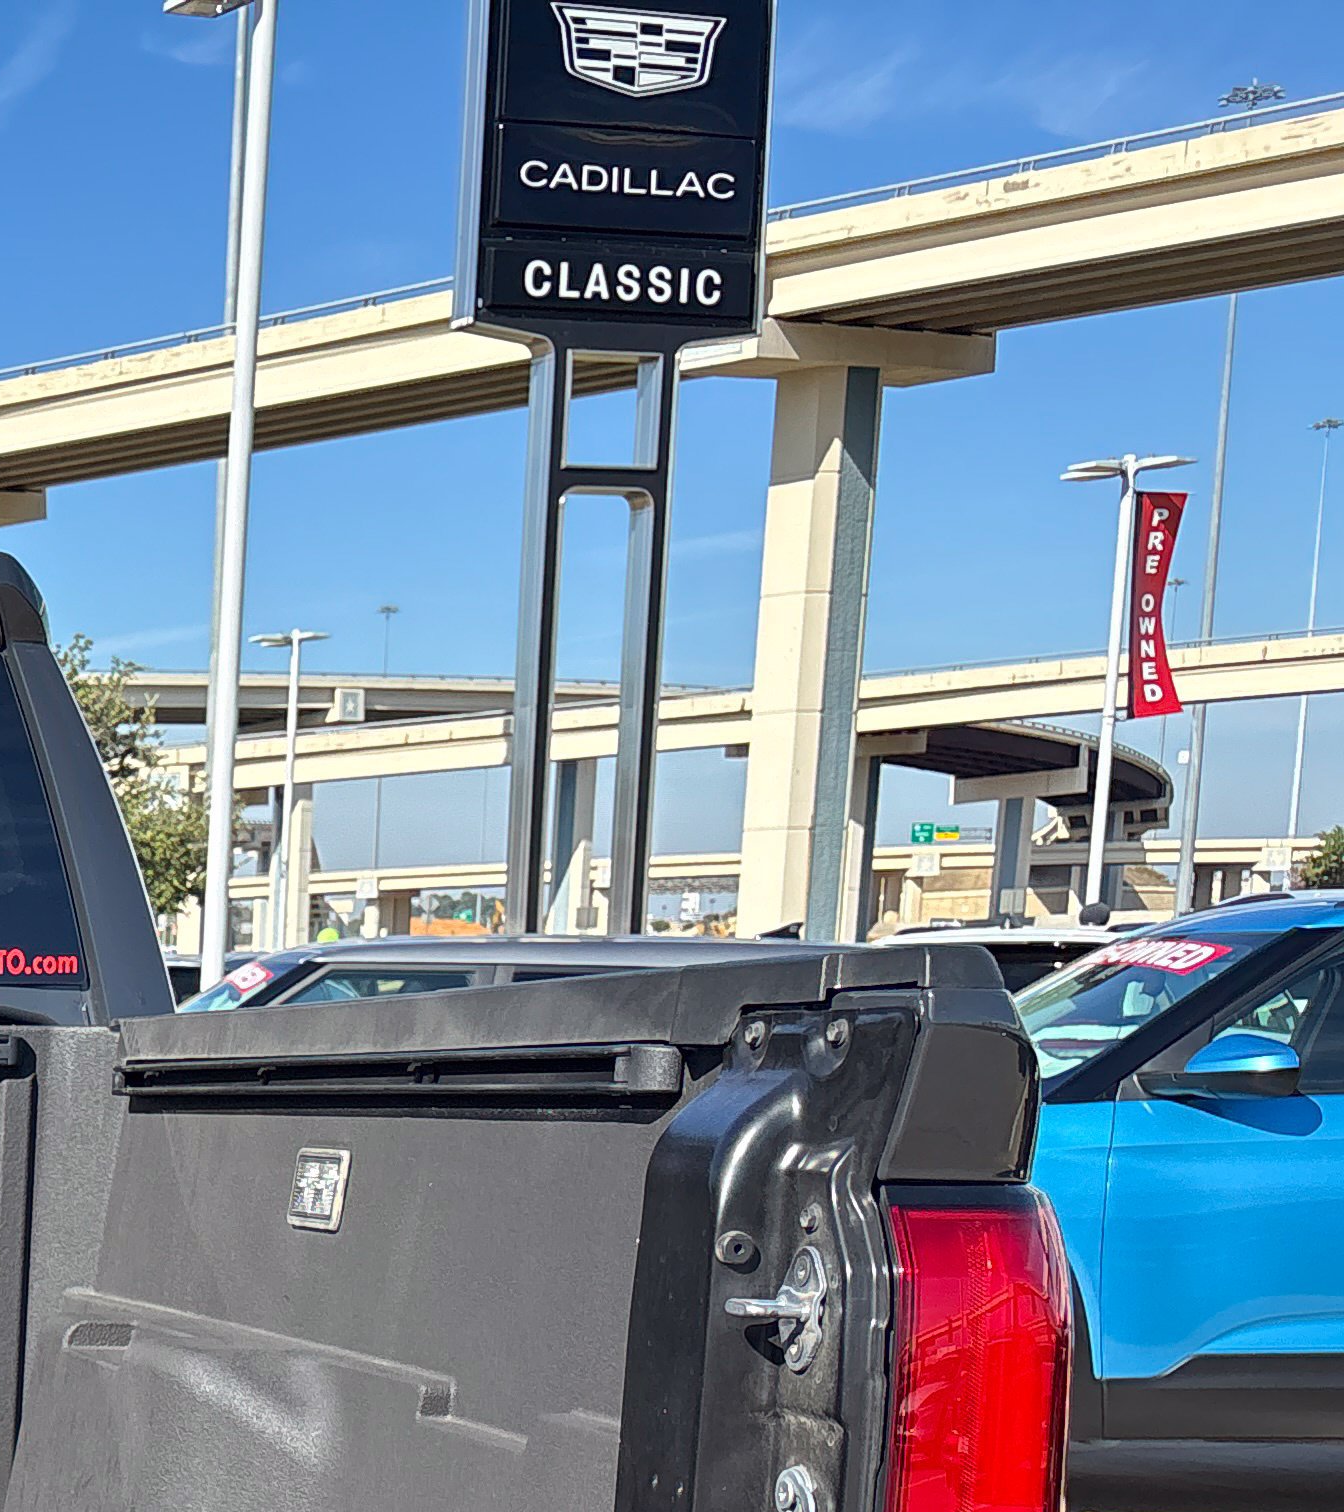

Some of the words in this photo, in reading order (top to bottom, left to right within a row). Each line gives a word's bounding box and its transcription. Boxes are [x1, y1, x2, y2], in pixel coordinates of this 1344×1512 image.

[519, 160, 737, 200] CADILLAC
[523, 260, 723, 306] CLASSIC
[1144, 507, 1170, 575] PRE
[1138, 593, 1164, 703] OWNED
